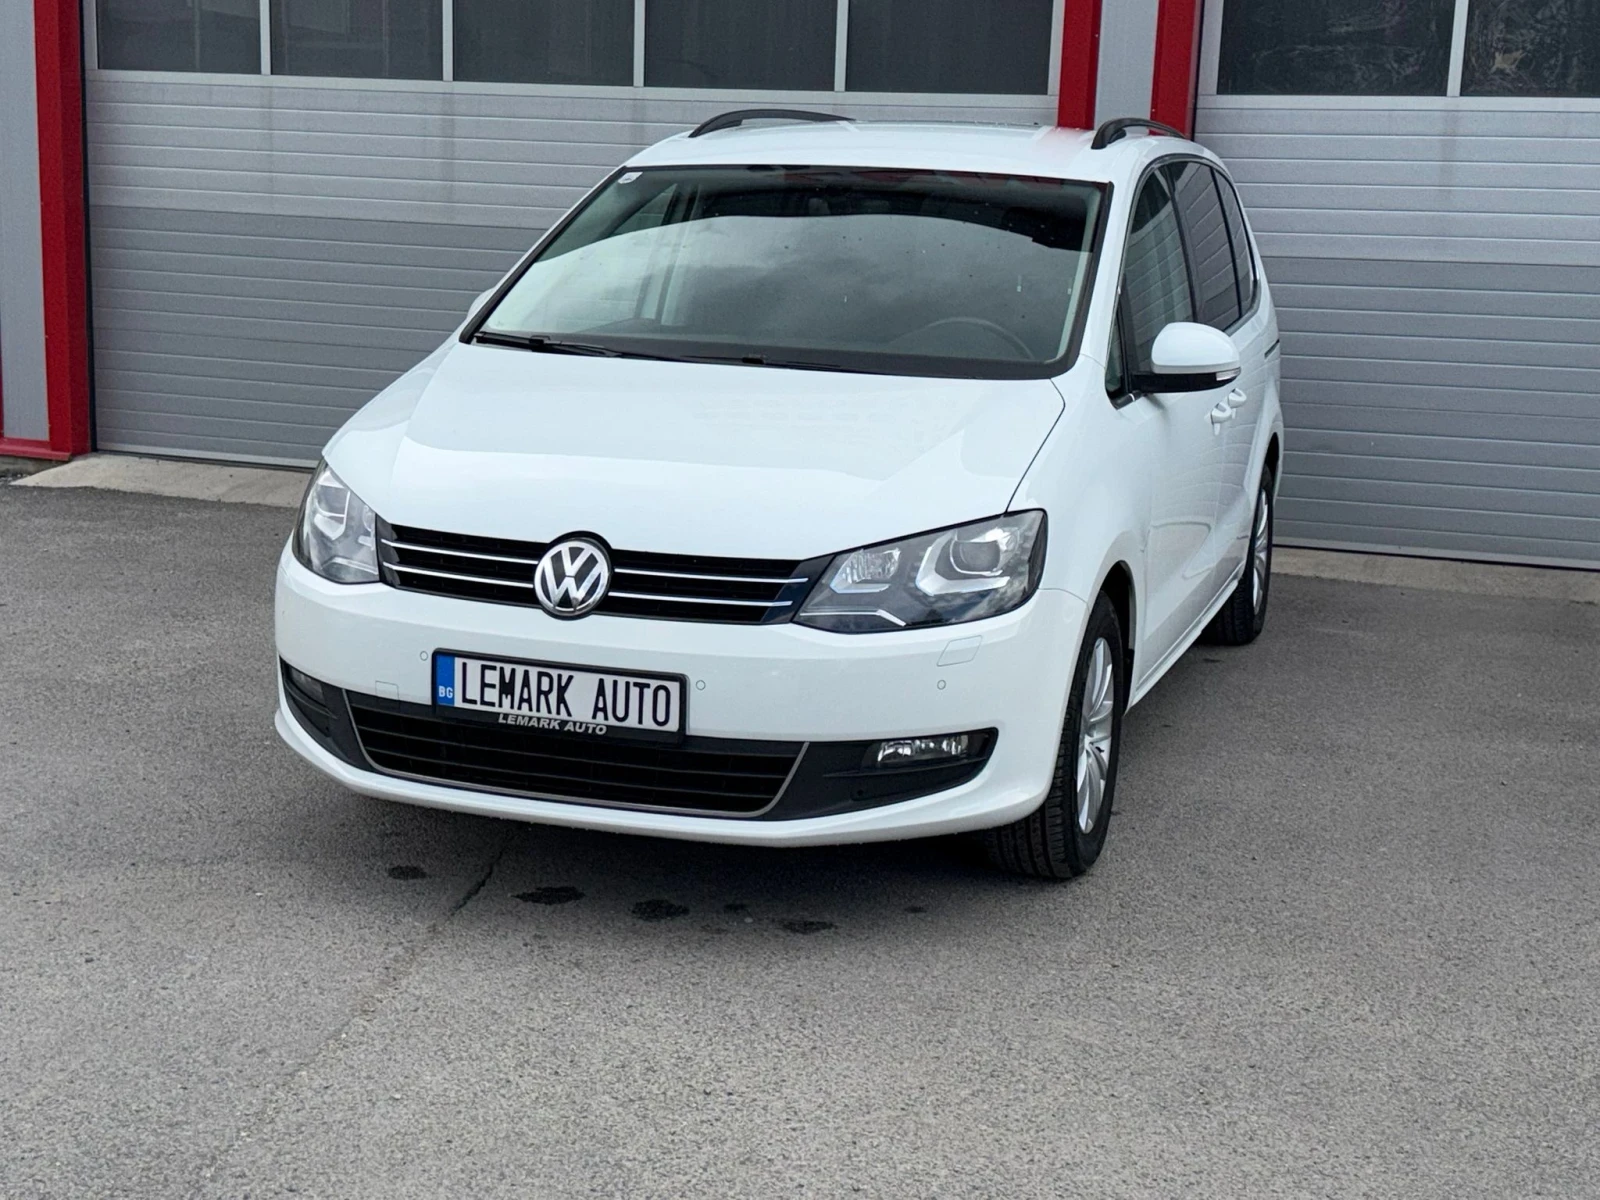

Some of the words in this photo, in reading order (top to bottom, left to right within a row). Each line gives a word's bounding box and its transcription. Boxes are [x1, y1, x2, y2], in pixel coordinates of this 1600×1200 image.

[438, 685, 453, 698] BG
[462, 662, 574, 717] LEMARK
[592, 678, 671, 726] AUTO
[498, 713, 560, 730] LEMARK
[564, 722, 607, 735] AUTO
